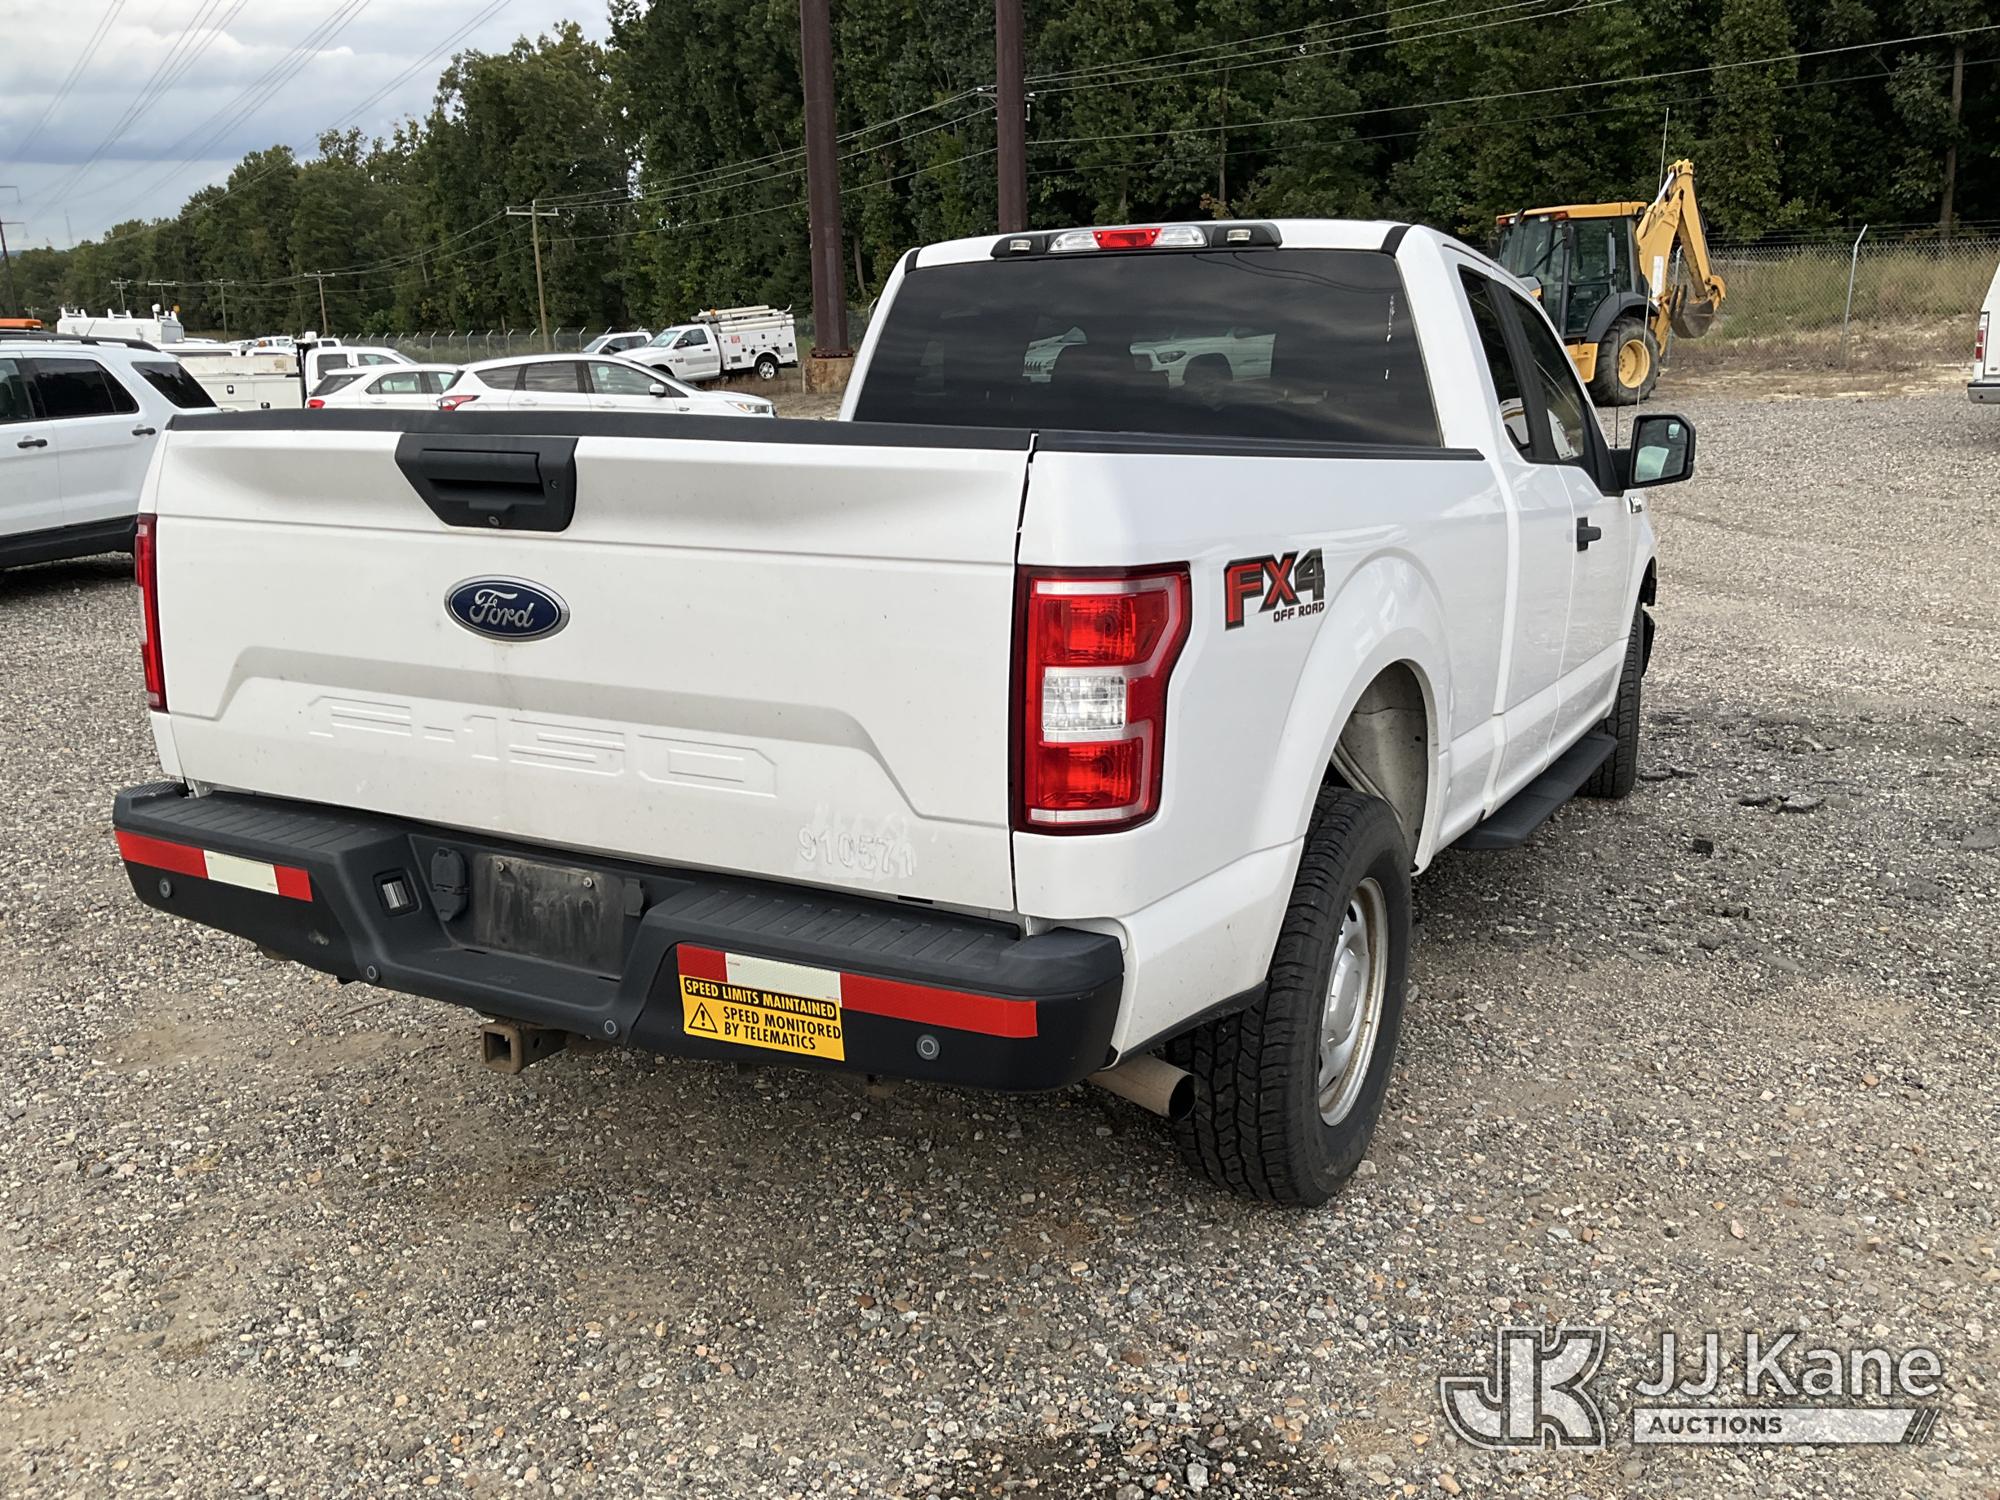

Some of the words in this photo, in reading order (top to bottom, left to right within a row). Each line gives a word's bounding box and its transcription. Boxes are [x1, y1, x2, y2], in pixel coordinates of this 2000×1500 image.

[469, 588, 535, 628] Ford
[1224, 548, 1325, 631] FX4
[1273, 607, 1295, 623] OFF
[1298, 601, 1325, 617] ROAD
[308, 695, 778, 798] F-150
[685, 979, 719, 998] SPEED
[722, 986, 759, 1005] LIMITS
[762, 993, 835, 1018] MAINTAINED
[723, 1006, 759, 1024] SPEED
[764, 1014, 841, 1040] MONITORED
[724, 1021, 740, 1036] BY
[744, 1025, 816, 1050] TELEMATICS
